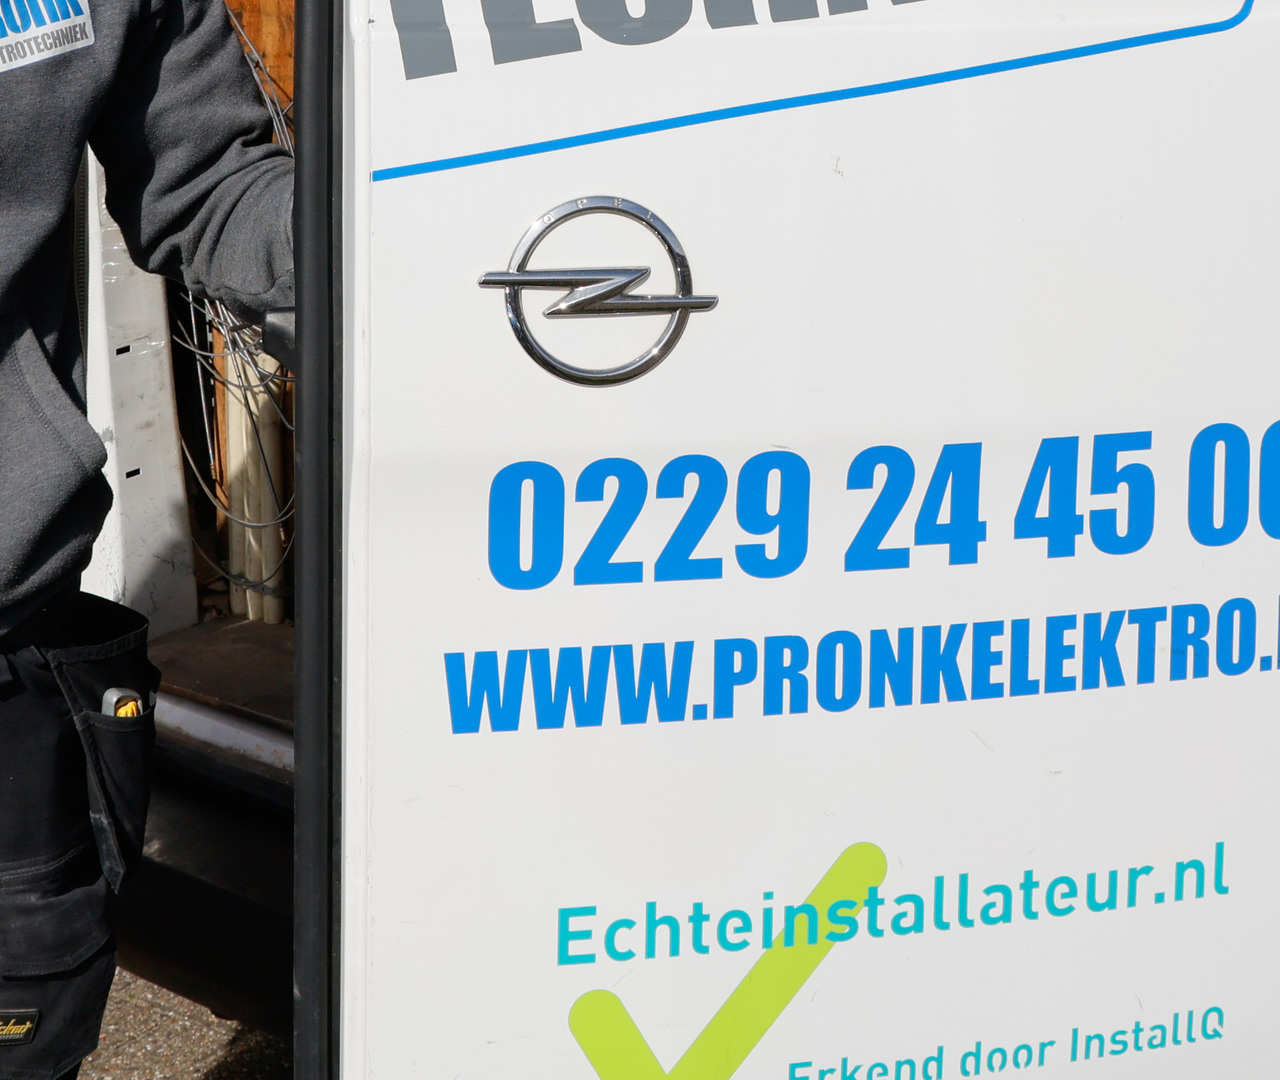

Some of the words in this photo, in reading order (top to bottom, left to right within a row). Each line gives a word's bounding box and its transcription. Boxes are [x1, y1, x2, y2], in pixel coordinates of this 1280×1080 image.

[489, 451, 810, 589] 0229
[845, 443, 986, 571] 24
[1015, 431, 1154, 557] 45
[559, 842, 1228, 966] Echteinstallateur.nl
[960, 1042, 1056, 1077] door
[1072, 1007, 1224, 1062] InstallQ
